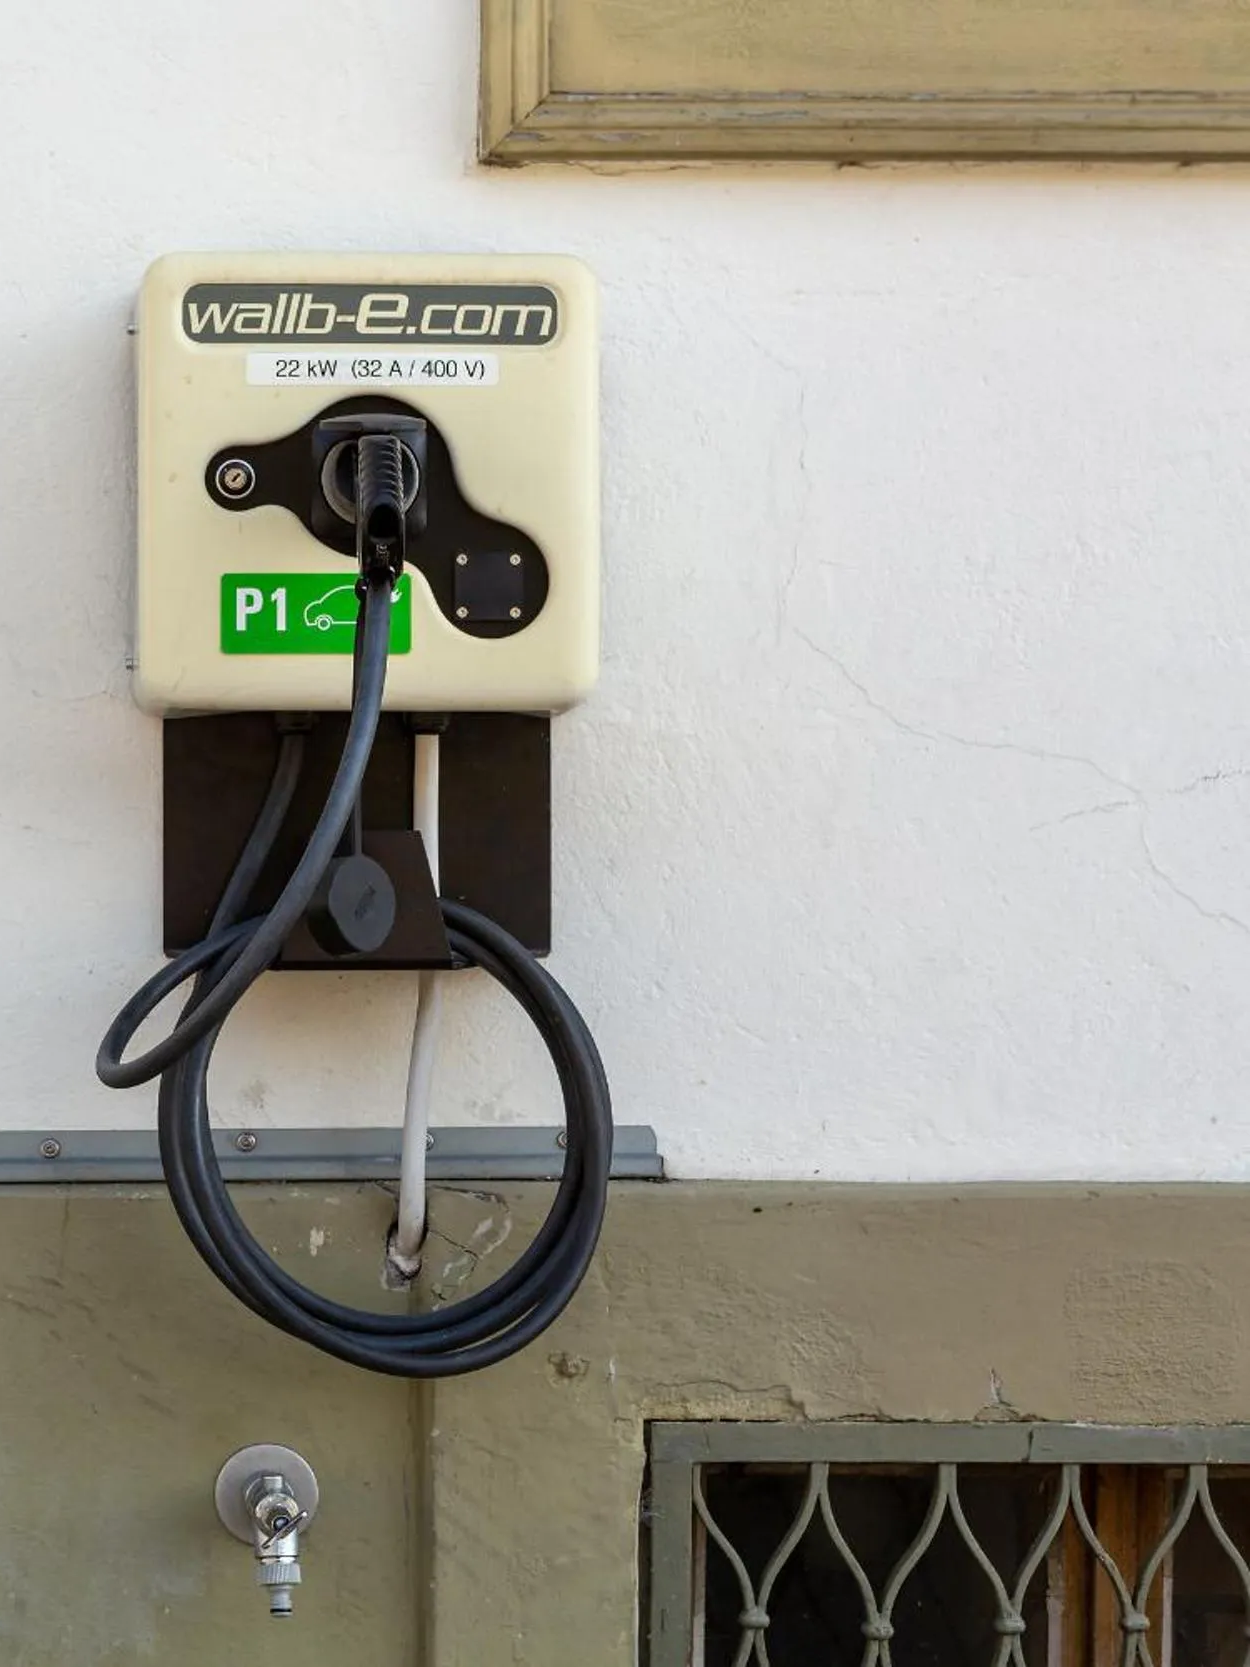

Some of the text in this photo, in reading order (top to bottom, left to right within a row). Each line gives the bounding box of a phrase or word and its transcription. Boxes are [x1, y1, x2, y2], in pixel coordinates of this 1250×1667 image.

[187, 292, 551, 337] wallb-e.com
[275, 358, 485, 380] 22 kW (32 A / 400 V)
